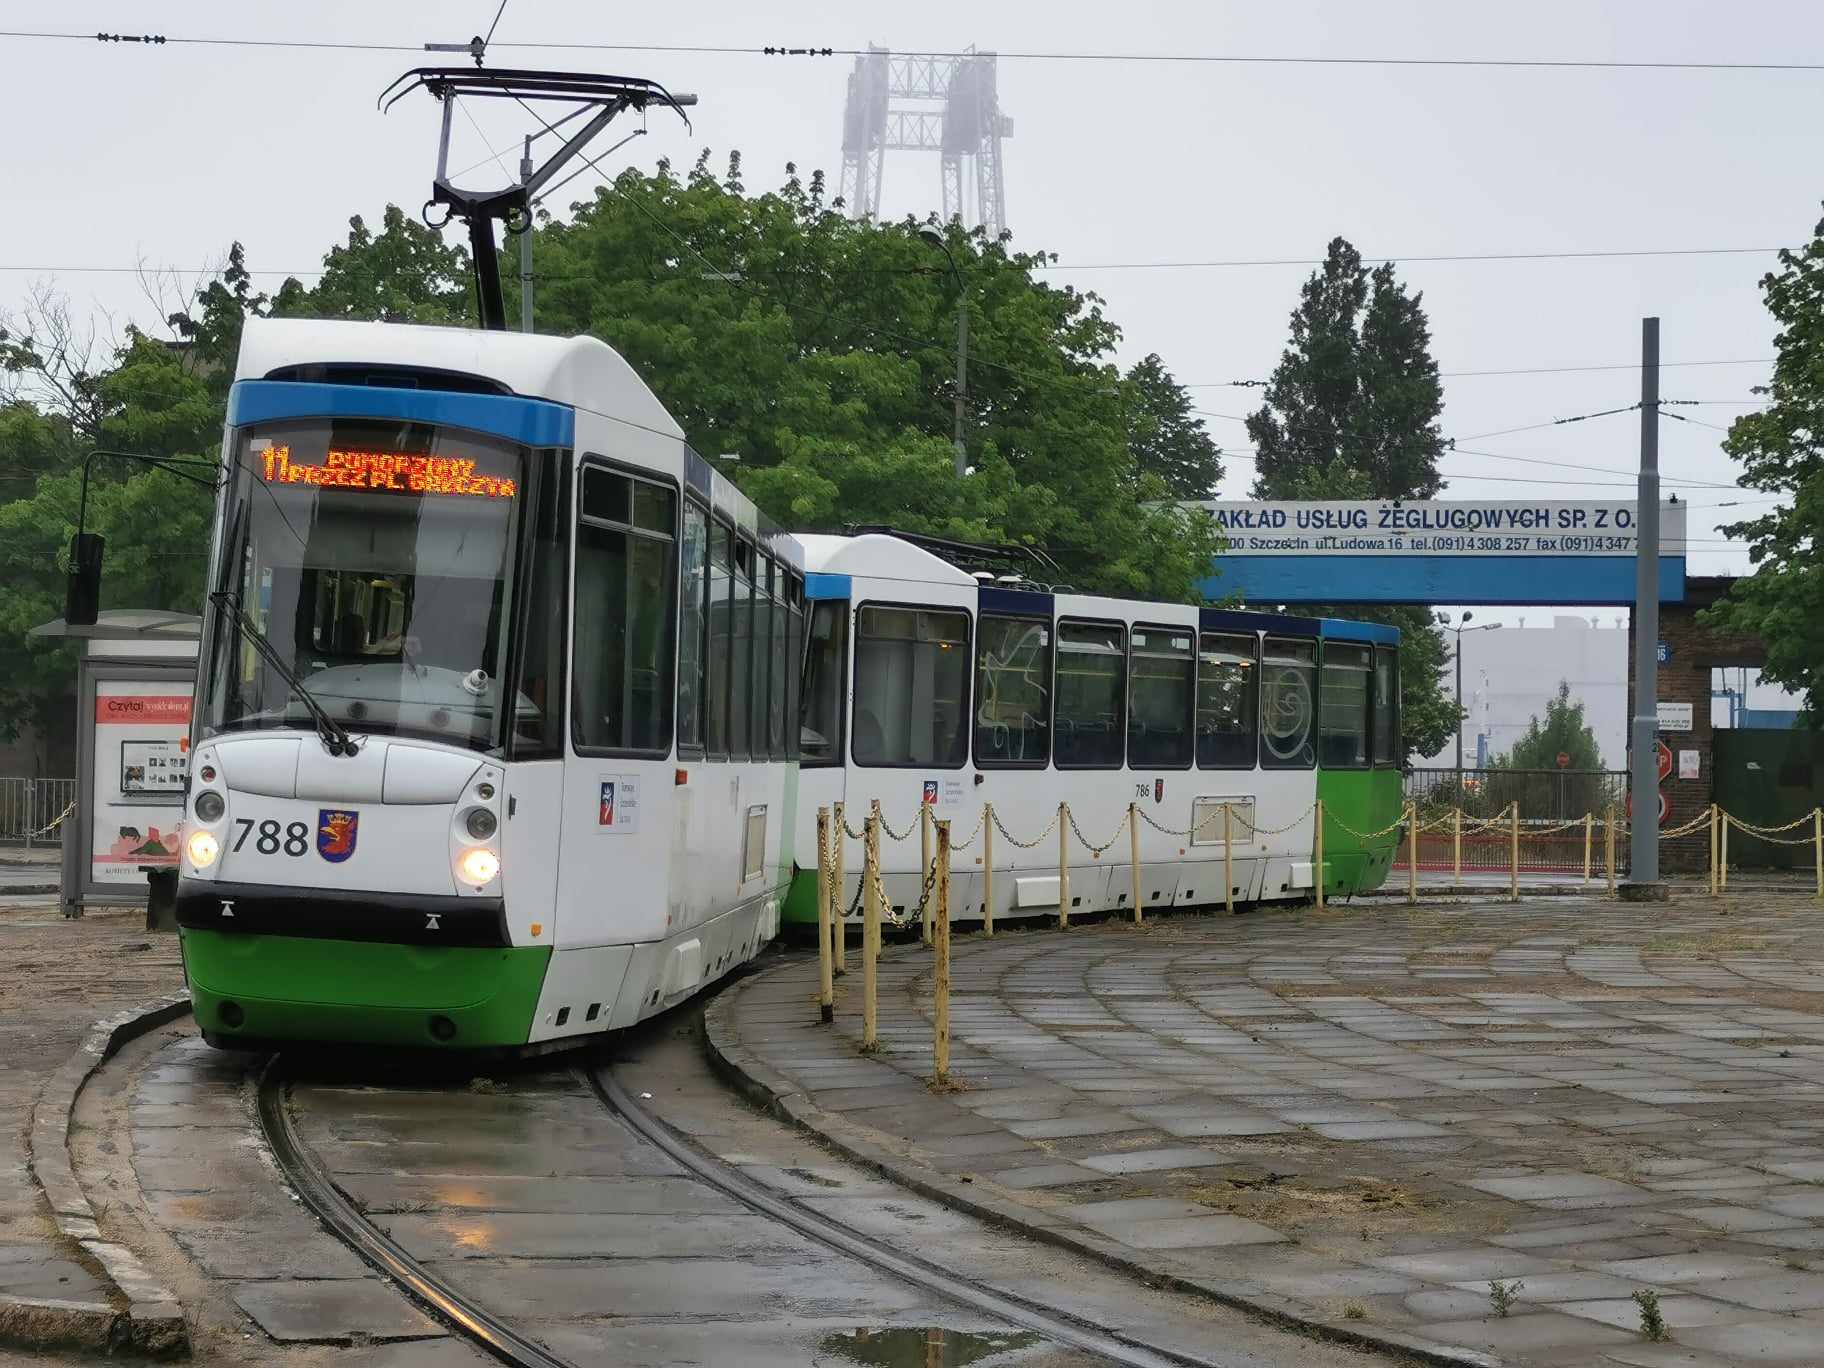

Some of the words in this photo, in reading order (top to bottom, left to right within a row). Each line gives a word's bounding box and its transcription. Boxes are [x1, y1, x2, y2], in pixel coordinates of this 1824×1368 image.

[262, 447, 289, 483] 11
[1297, 509, 1368, 529] USŁUG
[1378, 504, 1550, 530] ŻEGLUGOWYCH
[1557, 508, 1587, 529] SP.
[1594, 509, 1609, 528] Z
[1614, 508, 1636, 529] O.
[1249, 537, 1309, 550] Szczecin
[1388, 537, 1403, 550] 16
[1506, 537, 1530, 550] 257
[1536, 536, 1557, 550] fax
[108, 700, 144, 713] Czytaj
[1135, 783, 1150, 798] 786
[231, 817, 309, 858] 788
